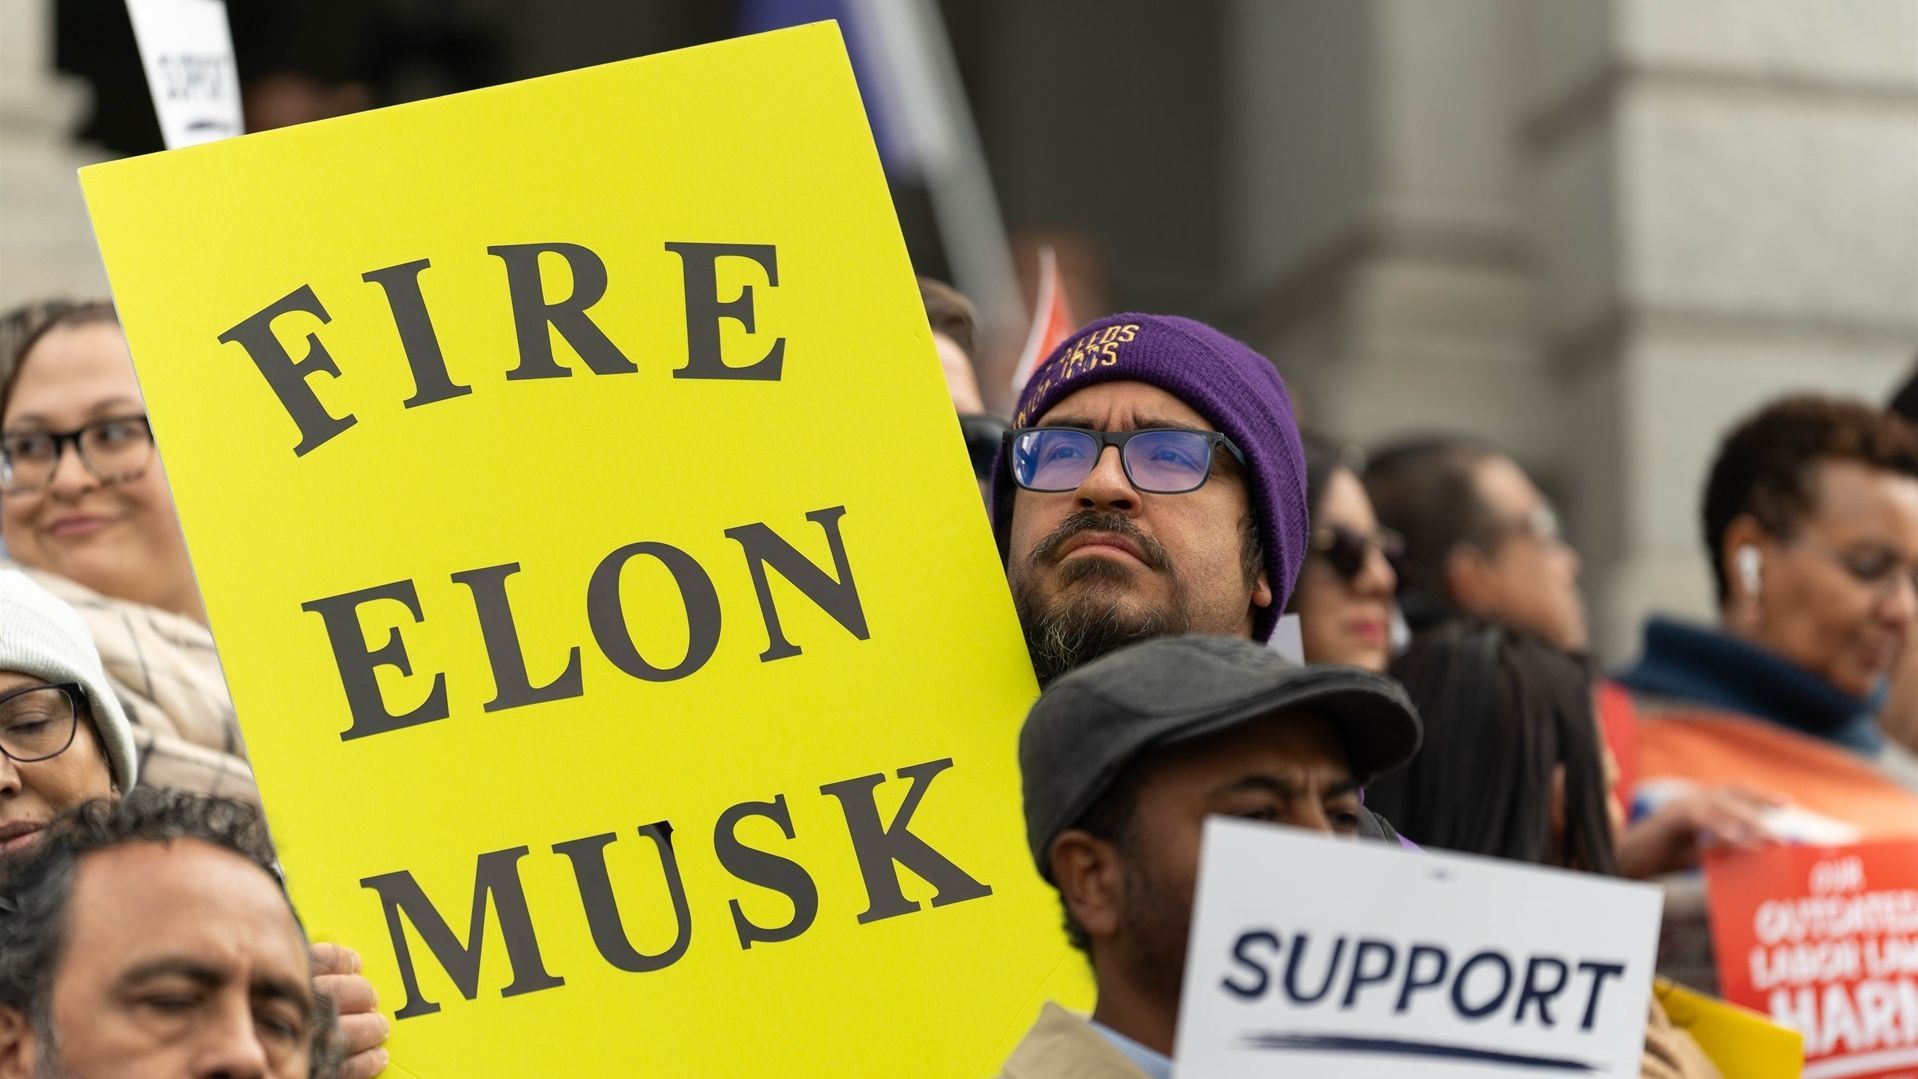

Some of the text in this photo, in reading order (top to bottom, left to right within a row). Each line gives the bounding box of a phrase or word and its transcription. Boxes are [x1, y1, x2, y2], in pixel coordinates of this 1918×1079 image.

[218, 242, 785, 457] FIRE
[302, 506, 870, 741] ELON
[360, 758, 992, 1020] MUSK
[1221, 929, 1626, 1031] SUPPORT
